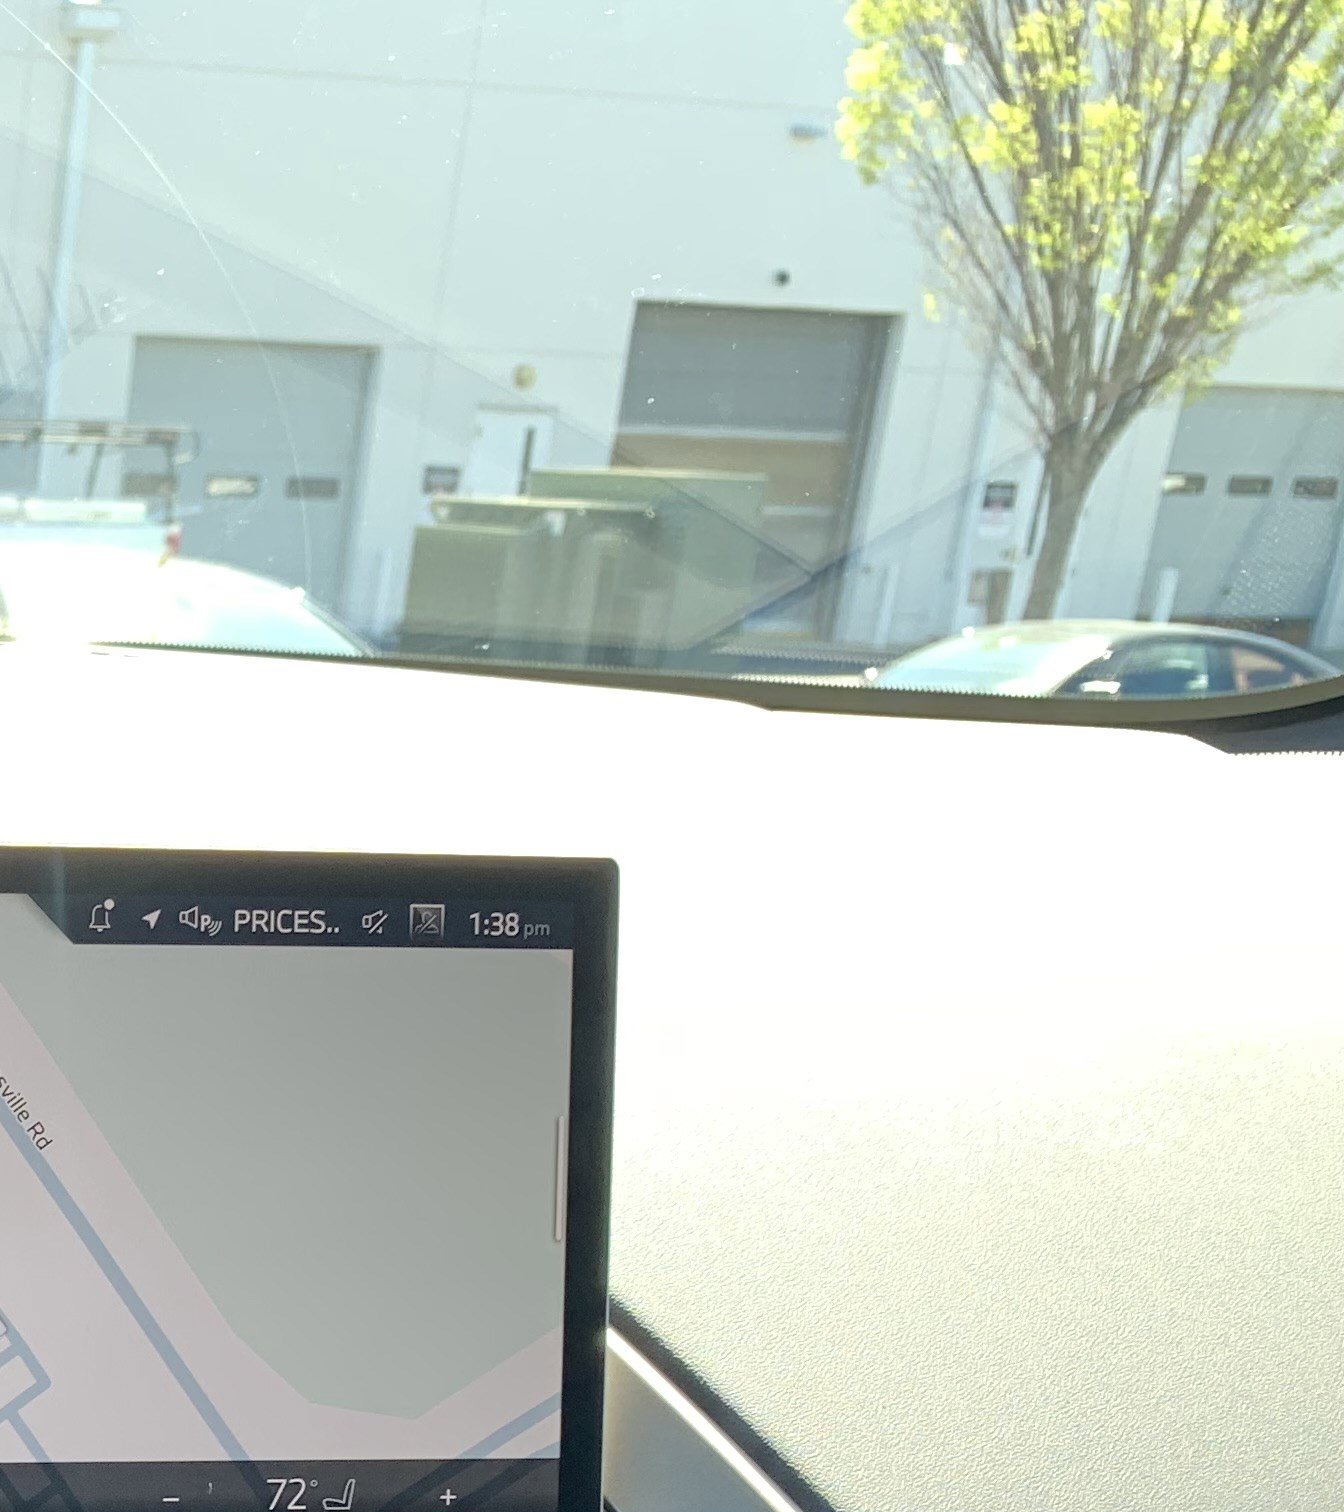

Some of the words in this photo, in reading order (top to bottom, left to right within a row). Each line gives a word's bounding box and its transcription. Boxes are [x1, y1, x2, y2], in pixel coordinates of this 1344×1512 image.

[234, 909, 341, 934] PRICES..
[469, 911, 520, 937] 1:38
[523, 923, 552, 939] pm
[26, 1121, 54, 1152] Rd
